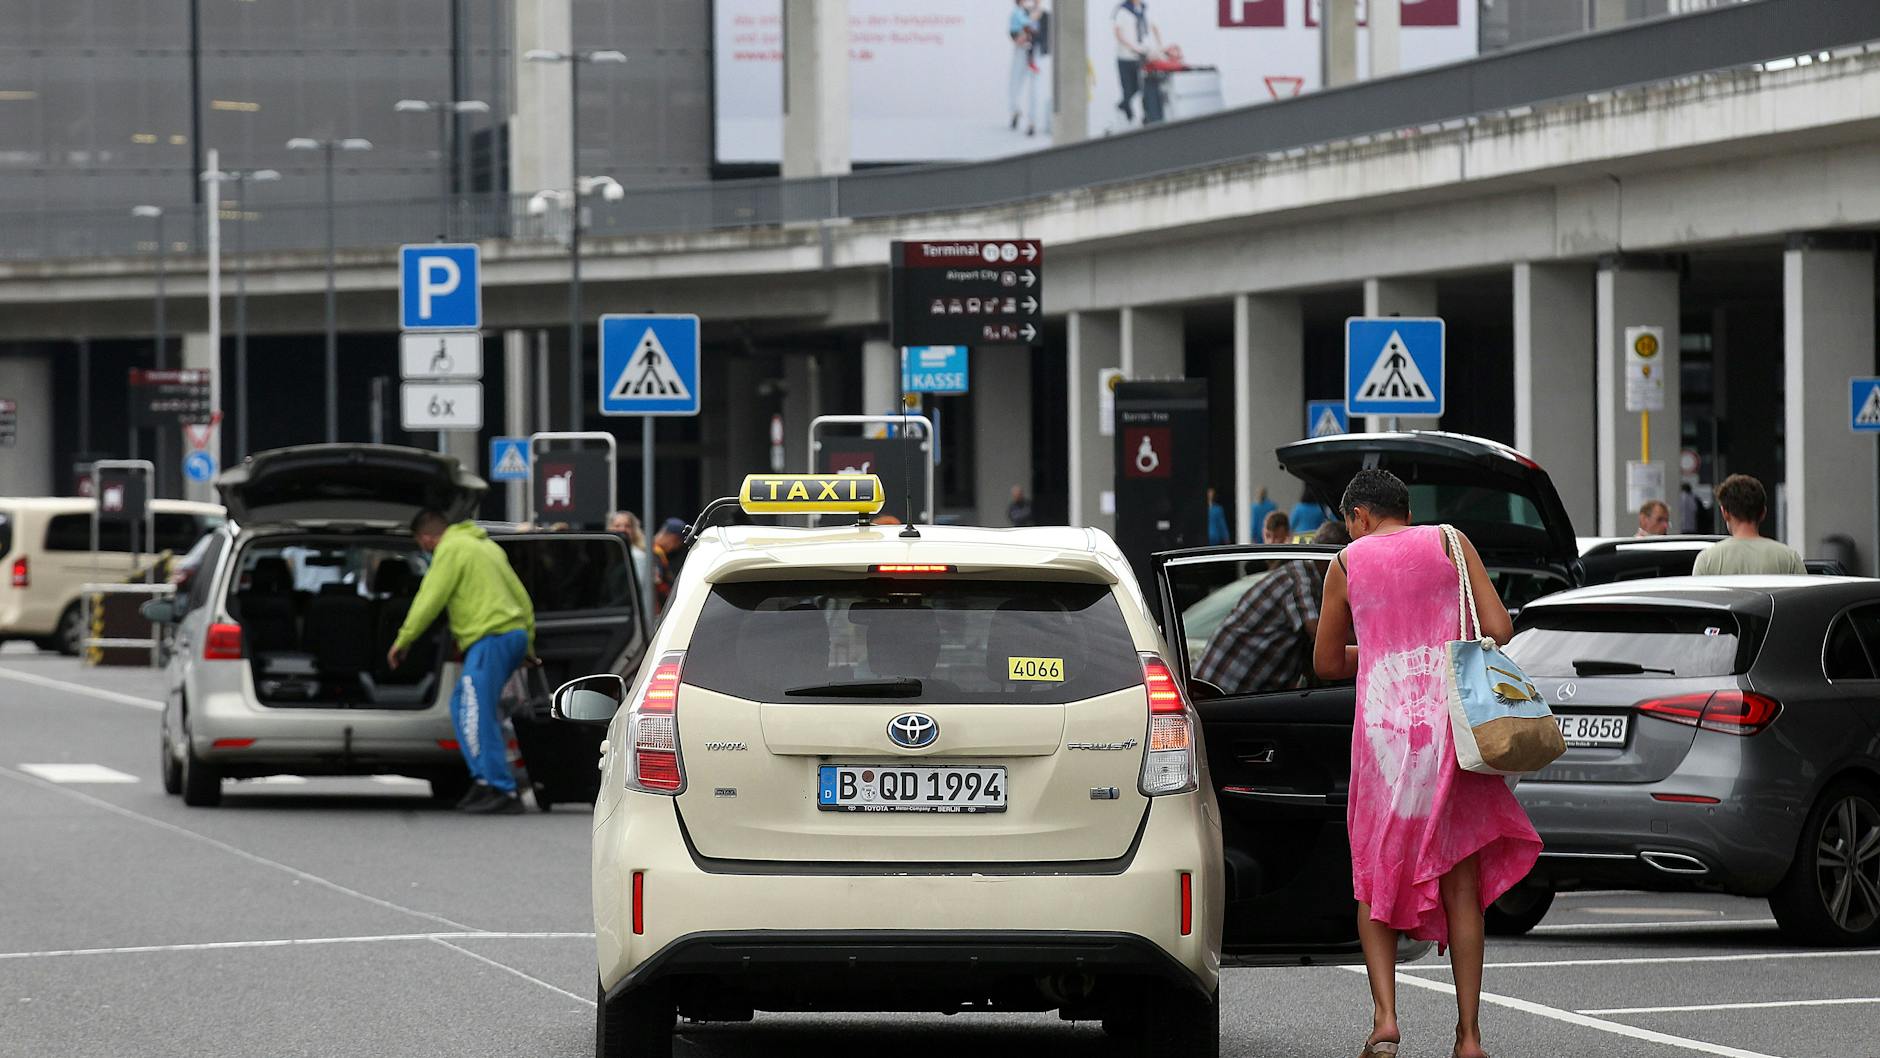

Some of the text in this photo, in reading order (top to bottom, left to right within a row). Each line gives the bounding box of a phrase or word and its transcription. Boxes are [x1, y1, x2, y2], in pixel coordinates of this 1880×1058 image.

[923, 243, 980, 257] Terminal
[946, 269, 999, 282] Airport City
[418, 256, 462, 320] P
[912, 373, 965, 389] KASSE
[428, 394, 455, 417] 6x
[764, 480, 857, 500] TAXI
[1013, 660, 1059, 678] 4066
[1556, 717, 1623, 739] E 8658
[704, 741, 749, 752] TOYOTA
[824, 789, 832, 799] D
[839, 771, 858, 800] B
[879, 772, 918, 801] QD
[926, 772, 1001, 801] 1994
[937, 805, 961, 813] BERLIN
